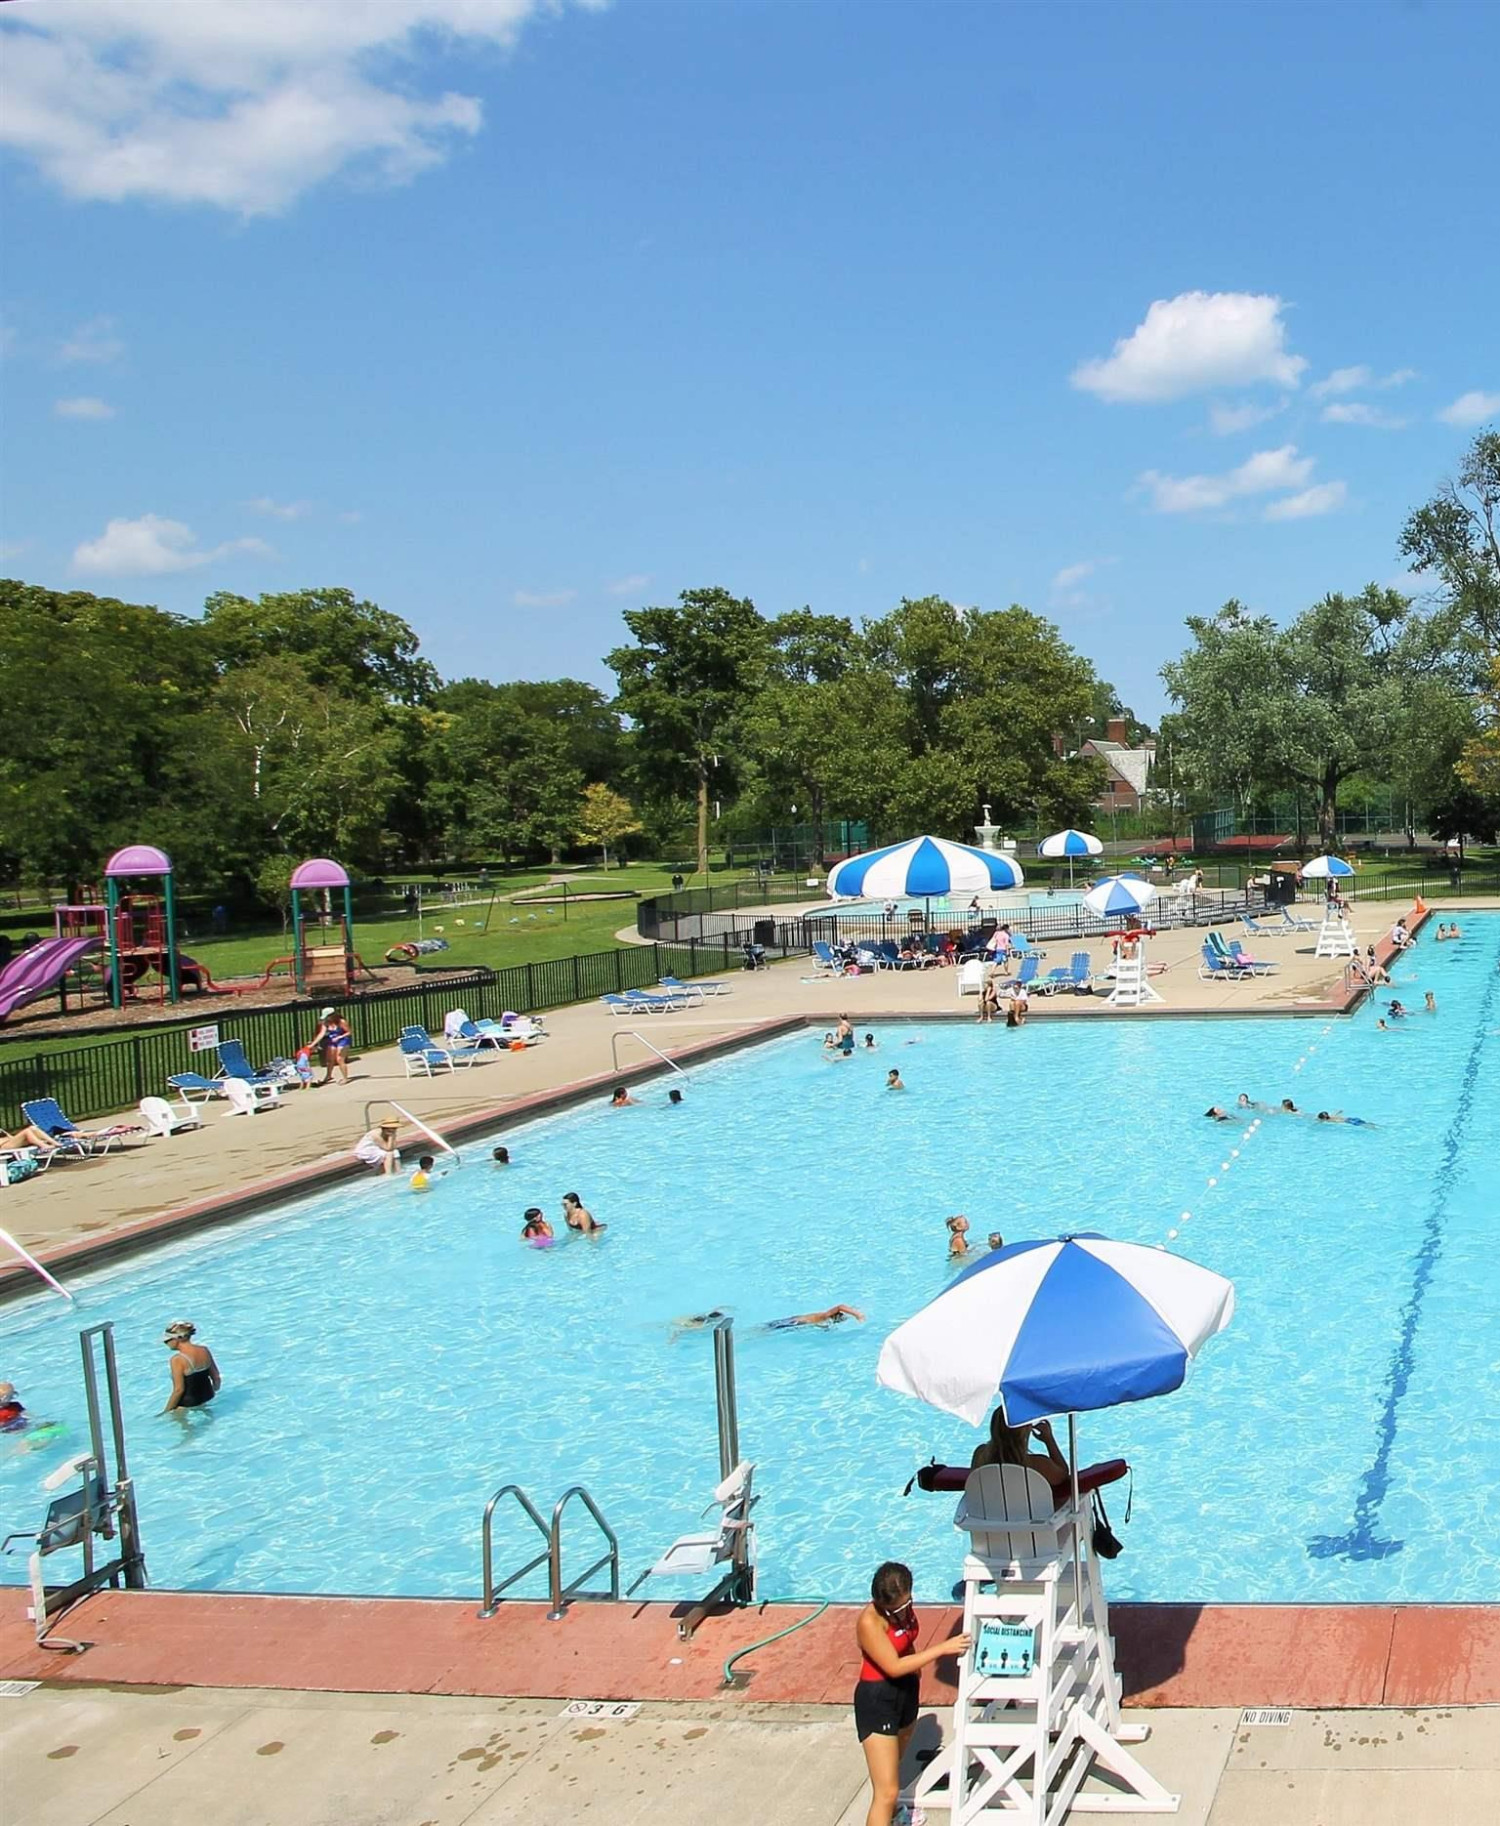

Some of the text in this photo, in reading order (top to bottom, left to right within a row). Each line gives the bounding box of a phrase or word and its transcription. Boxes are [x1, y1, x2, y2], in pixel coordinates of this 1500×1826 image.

[588, 1704, 628, 1715] 3 6
[1242, 1711, 1290, 1723] NO DIVING
